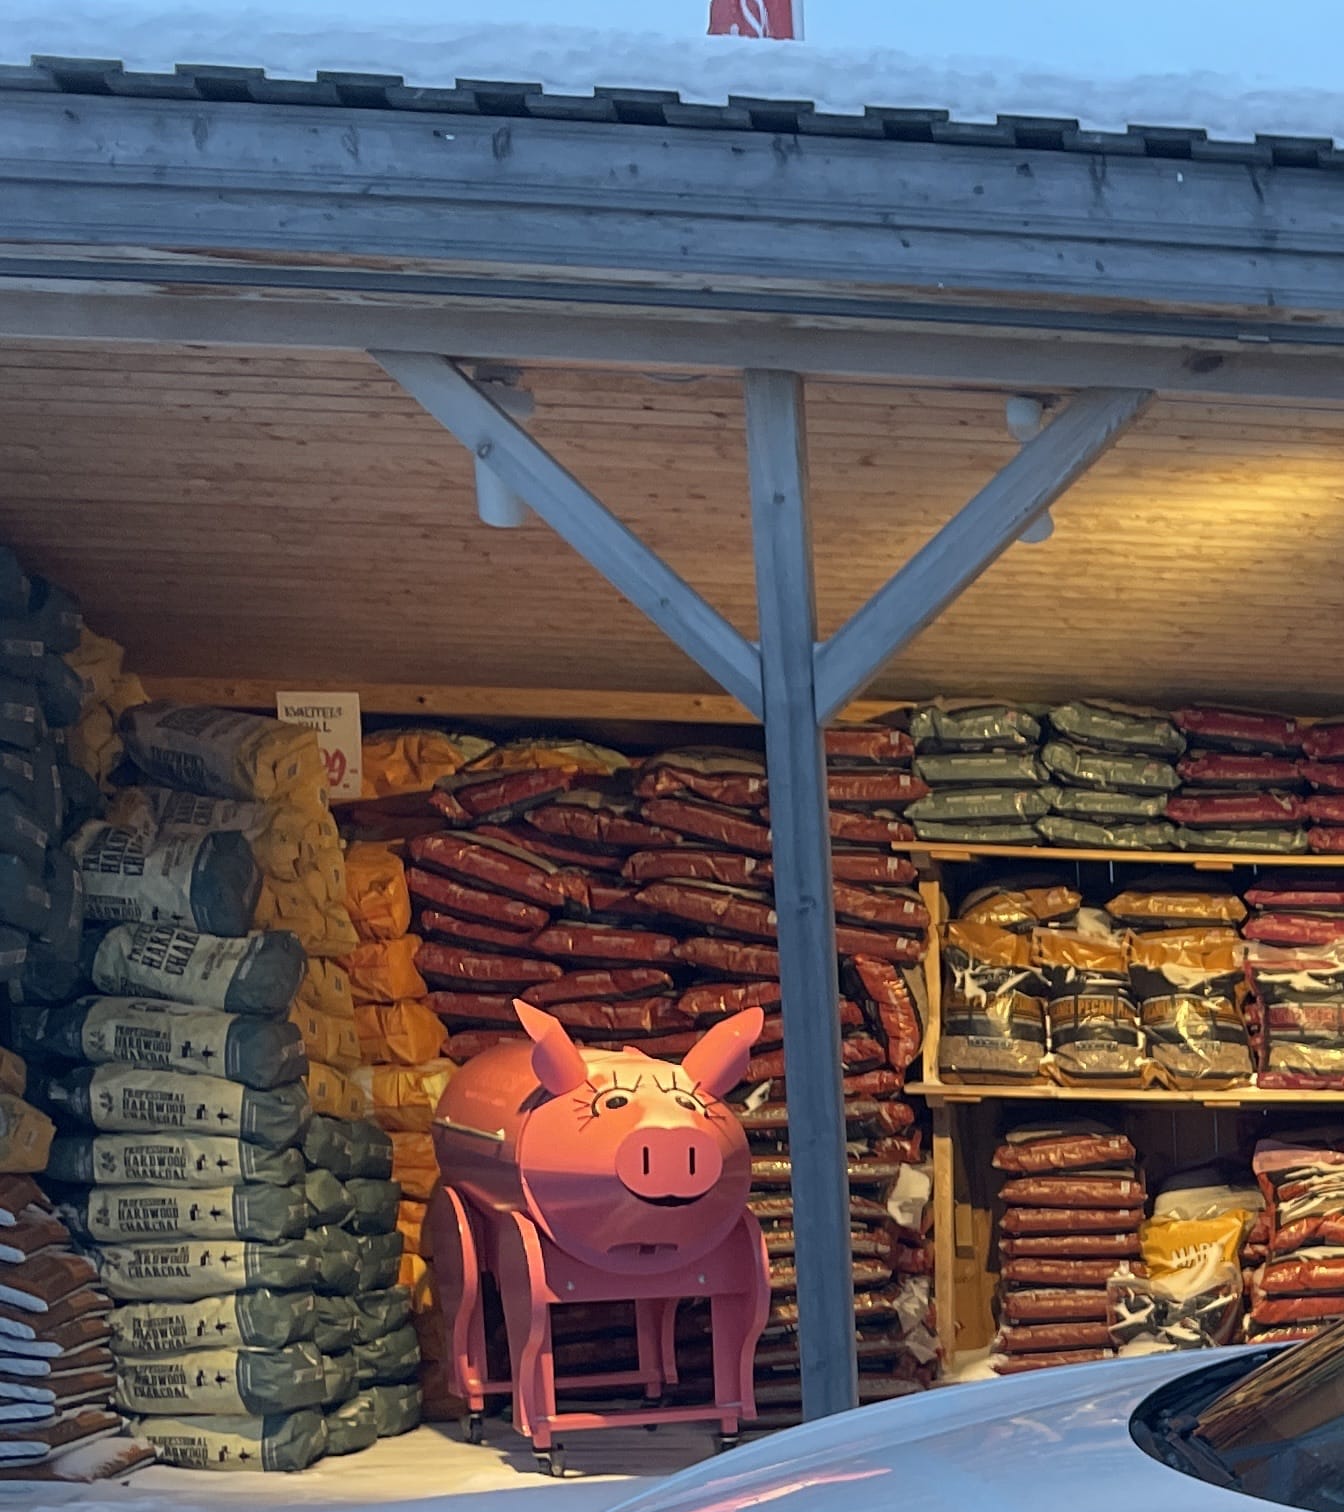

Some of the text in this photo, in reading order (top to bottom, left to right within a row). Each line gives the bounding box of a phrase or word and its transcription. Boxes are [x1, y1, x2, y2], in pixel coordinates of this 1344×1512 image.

[119, 1207, 179, 1221] HARDWOOD
[128, 1264, 191, 1278] CHARCOAL
[134, 1384, 189, 1399] CHARCOAL
